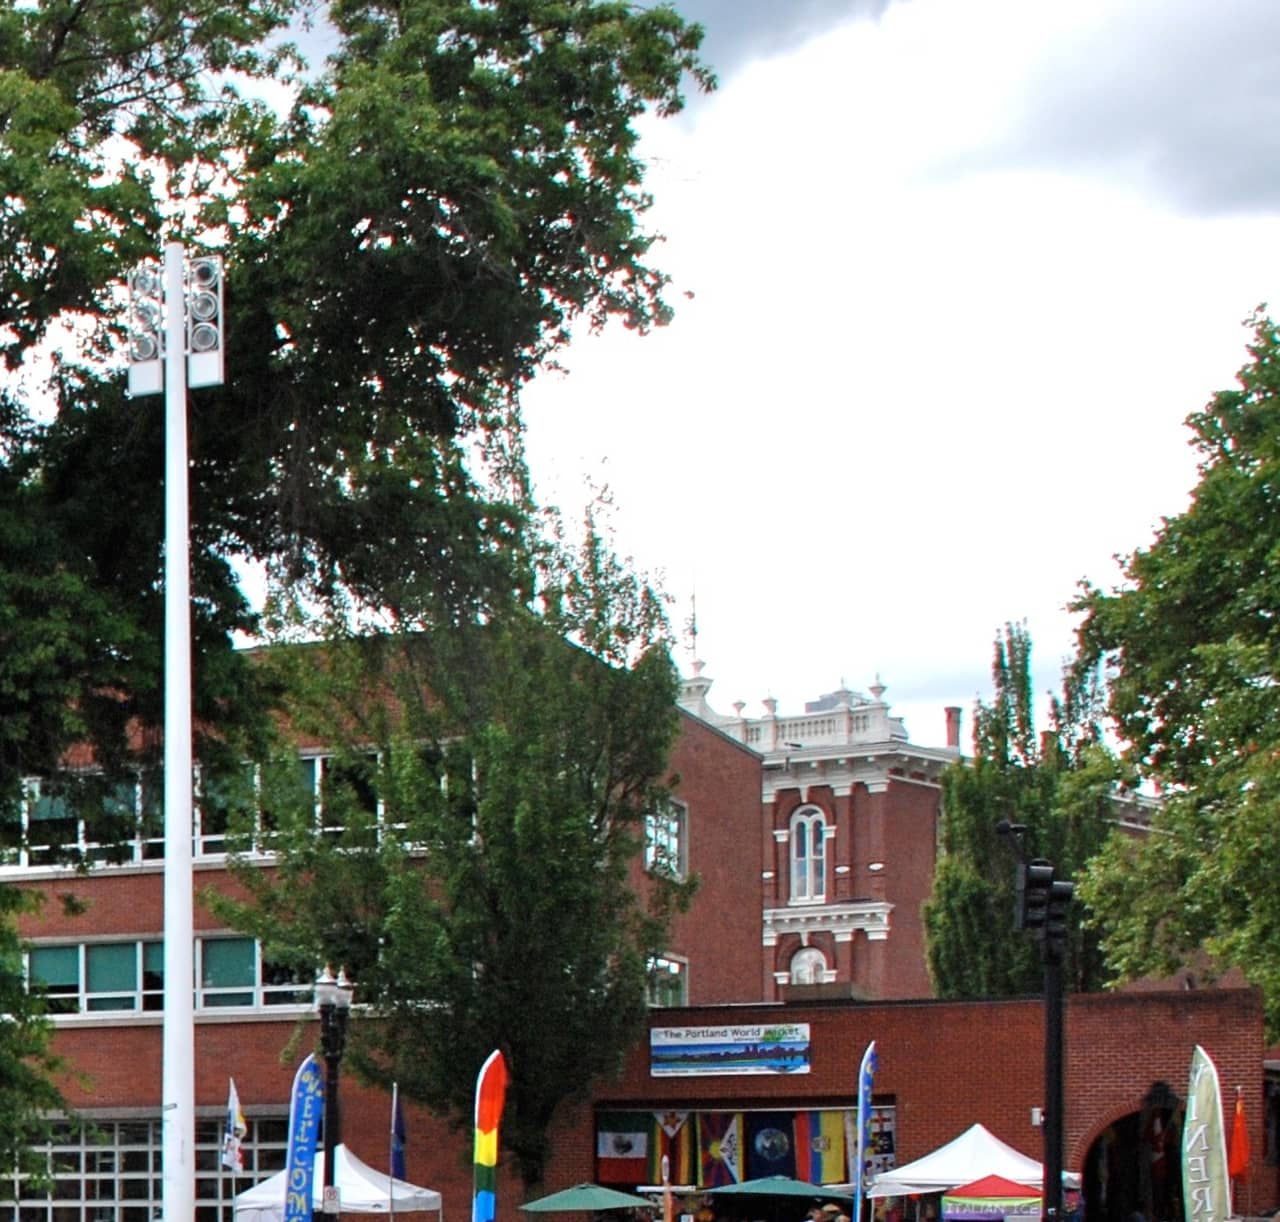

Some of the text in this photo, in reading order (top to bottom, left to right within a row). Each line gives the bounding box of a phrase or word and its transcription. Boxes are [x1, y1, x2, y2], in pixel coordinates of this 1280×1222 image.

[663, 1030, 682, 1039] The
[685, 1029, 728, 1039] Portland
[731, 1028, 760, 1038] World
[945, 1202, 1039, 1215] ITALIAN ICE
